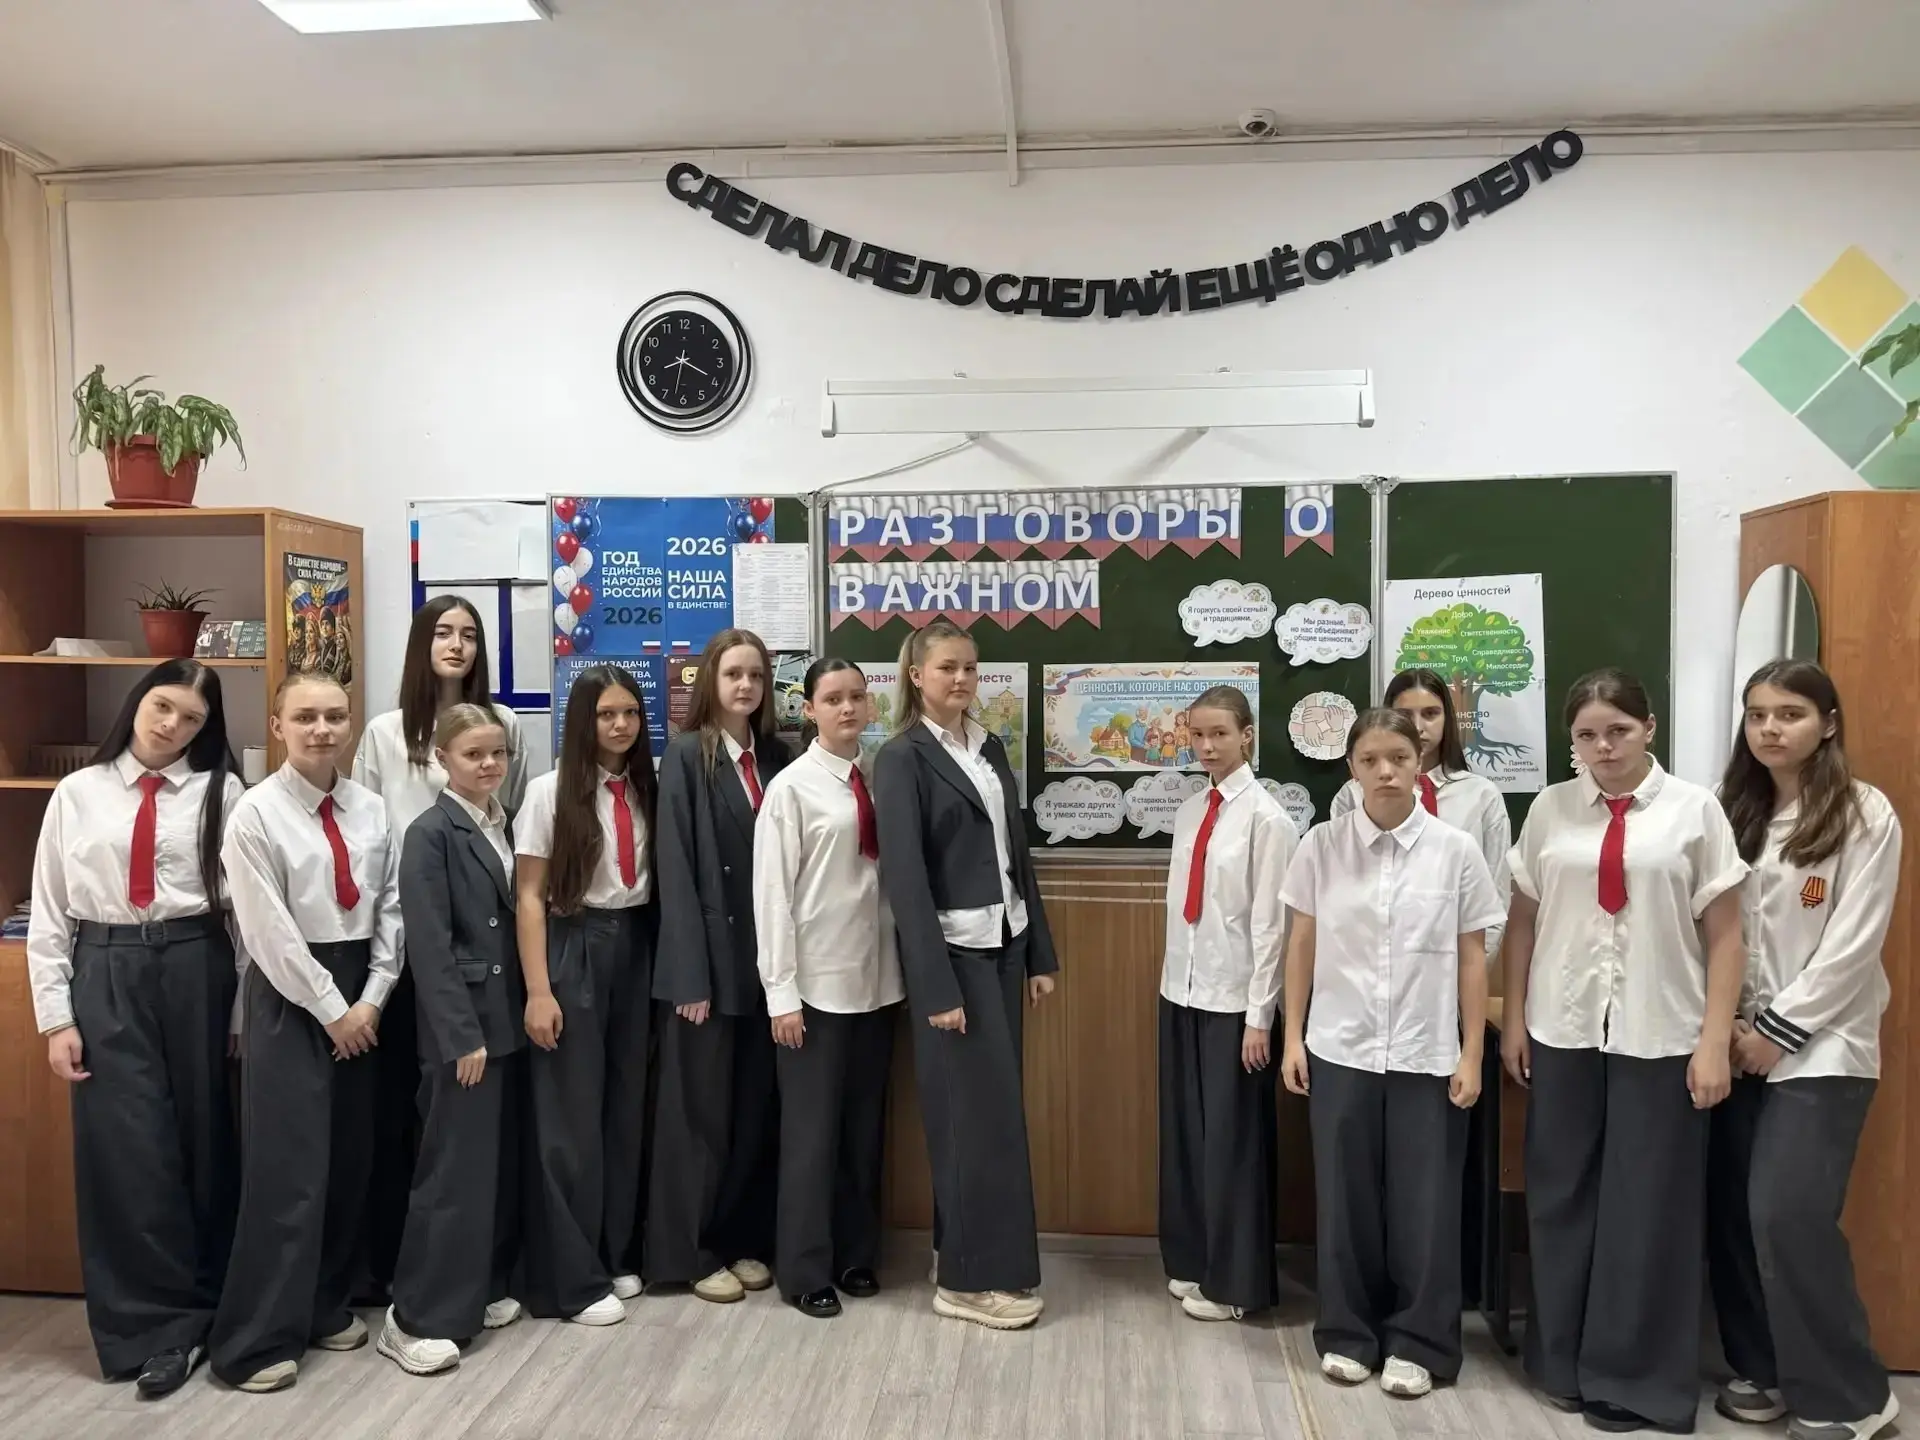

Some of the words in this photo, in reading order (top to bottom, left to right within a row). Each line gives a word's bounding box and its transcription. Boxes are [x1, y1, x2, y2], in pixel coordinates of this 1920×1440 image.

[666, 162, 851, 271] СДЕЛАЛ
[847, 241, 982, 306] ДЕЛО
[984, 267, 1181, 318] СДЕЛАЙ
[1186, 243, 1305, 312] ЕЩЁ
[1304, 200, 1449, 281] ОДНО
[1451, 129, 1583, 227] ДЕЛО
[662, 323, 672, 334] 11
[679, 319, 690, 330] 12
[700, 324, 705, 335] 1
[648, 337, 659, 348] 10
[711, 338, 719, 349] 2
[643, 355, 651, 366] 9
[716, 357, 724, 369] 3
[648, 374, 656, 385] 8
[711, 377, 719, 388] 4
[661, 388, 669, 399] 7
[697, 390, 705, 401] 5
[679, 394, 687, 405] 6
[839, 501, 1239, 547] РАЗГОВОРЫ
[1290, 501, 1328, 537] О
[666, 537, 727, 556] 2026
[602, 551, 640, 568] ГОД
[602, 567, 662, 576] ЕДИНСТВА
[668, 570, 727, 583] НАША
[602, 577, 662, 587] НАРОДОВ
[602, 587, 662, 598] РОССИИ
[668, 585, 726, 599] СИЛА
[839, 570, 1098, 613] ВАЖНОМ
[1413, 588, 1454, 600] Дерево
[668, 602, 674, 610] В
[676, 602, 727, 610] ЕДИНСТВЕ!
[1194, 607, 1221, 615] горжусь
[1222, 605, 1242, 613] своей
[603, 607, 663, 625] 2026
[1209, 615, 1252, 623] традициями.
[1303, 617, 1315, 625] Мы
[1317, 619, 1346, 627] разные,
[1314, 626, 1359, 635] объединяют
[1318, 635, 1354, 643] ценности.
[571, 660, 598, 669] ЦЕЛИ
[866, 674, 896, 684] разн
[977, 674, 1013, 683] месте
[1076, 682, 1127, 694] ЦЕННОСТИ,
[1129, 682, 1172, 692] КОТОРЫЕ
[1174, 681, 1191, 692] НАС
[1455, 711, 1490, 719] инство
[1459, 721, 1484, 732] рода
[1045, 801, 1051, 809] Я
[1053, 802, 1084, 811] уважаю
[1087, 801, 1116, 811] других
[1053, 811, 1077, 821] умею
[1078, 811, 1115, 821] слушать.
